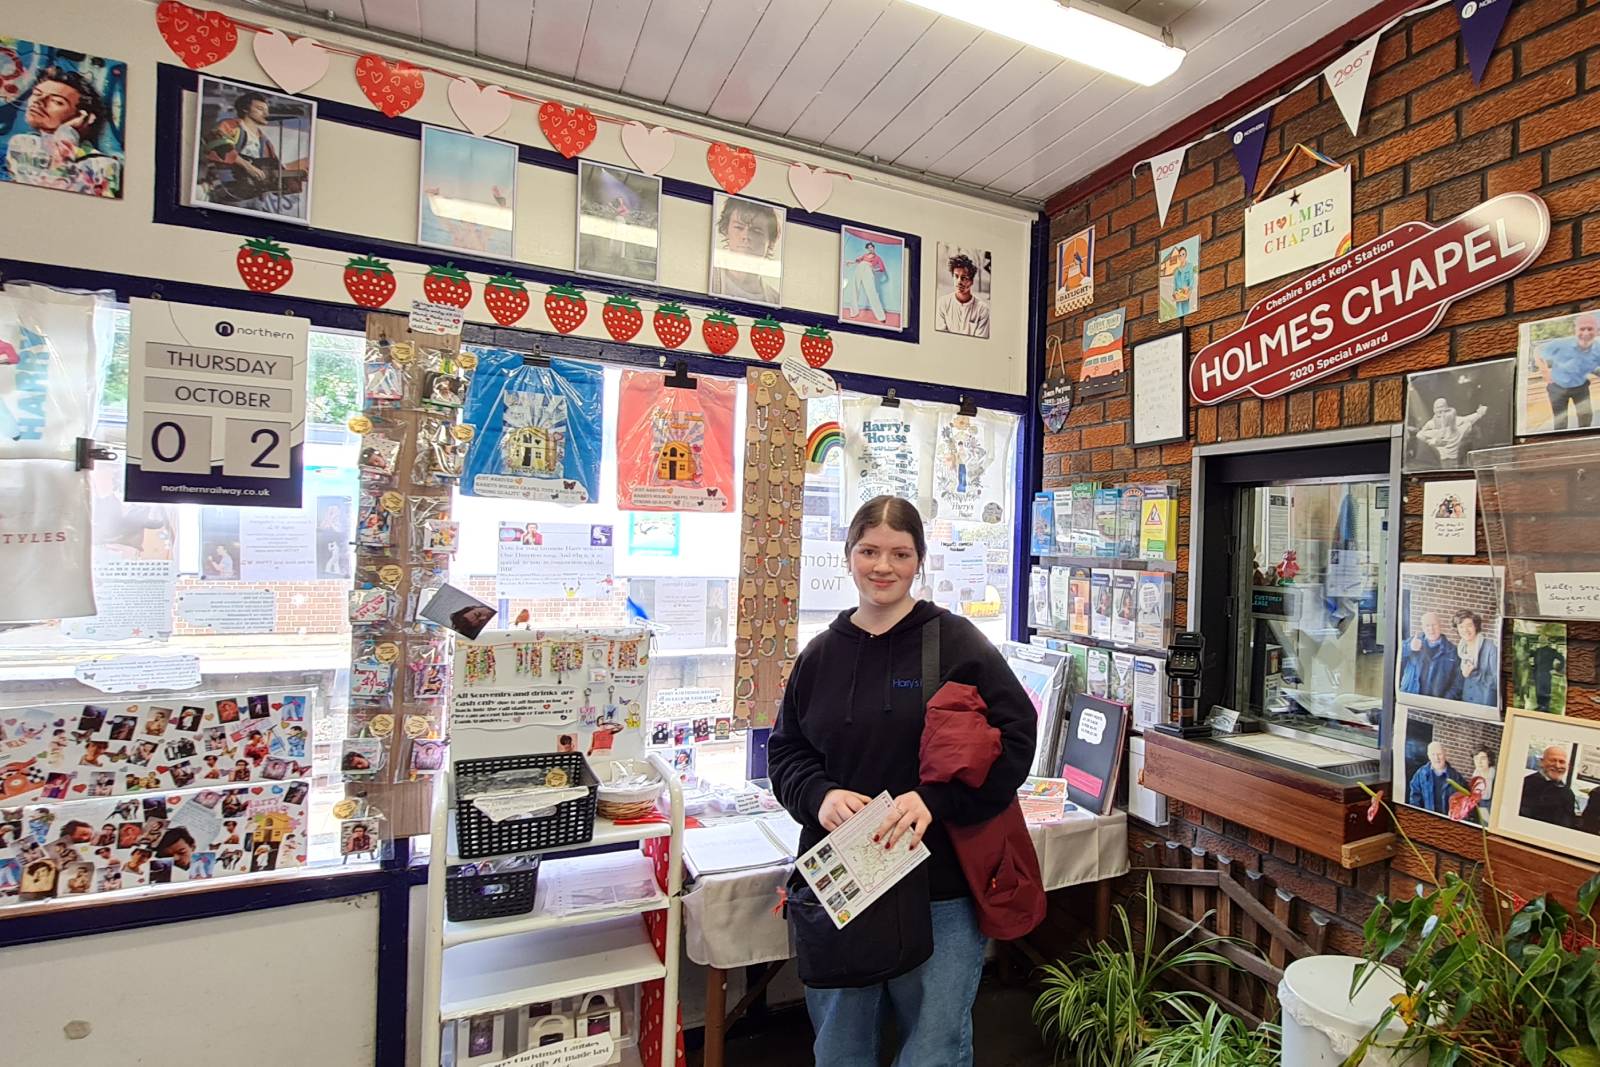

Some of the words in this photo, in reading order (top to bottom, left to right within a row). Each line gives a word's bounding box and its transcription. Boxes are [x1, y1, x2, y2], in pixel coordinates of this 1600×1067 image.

[1264, 219, 1335, 254] CHAPEL
[1265, 286, 1303, 311] Cheshire
[1304, 273, 1327, 291] Best
[1328, 259, 1353, 279] Kept
[1354, 239, 1395, 265] Station
[1060, 285, 1089, 302] DAYLIGHT
[1201, 303, 1334, 392] HOLMES
[1341, 217, 1527, 326] CHAPEL
[237, 327, 295, 340] northern
[167, 350, 277, 376] THURSDAY
[1289, 364, 1315, 381] 2020
[1316, 347, 1353, 370] Special
[1354, 331, 1389, 354] Award
[175, 386, 271, 408] OCTOBER
[862, 421, 911, 434] Harry's
[863, 432, 908, 443] House
[151, 421, 186, 463] 0
[250, 428, 280, 469] 2
[161, 484, 271, 497] northernrailway.co.uk
